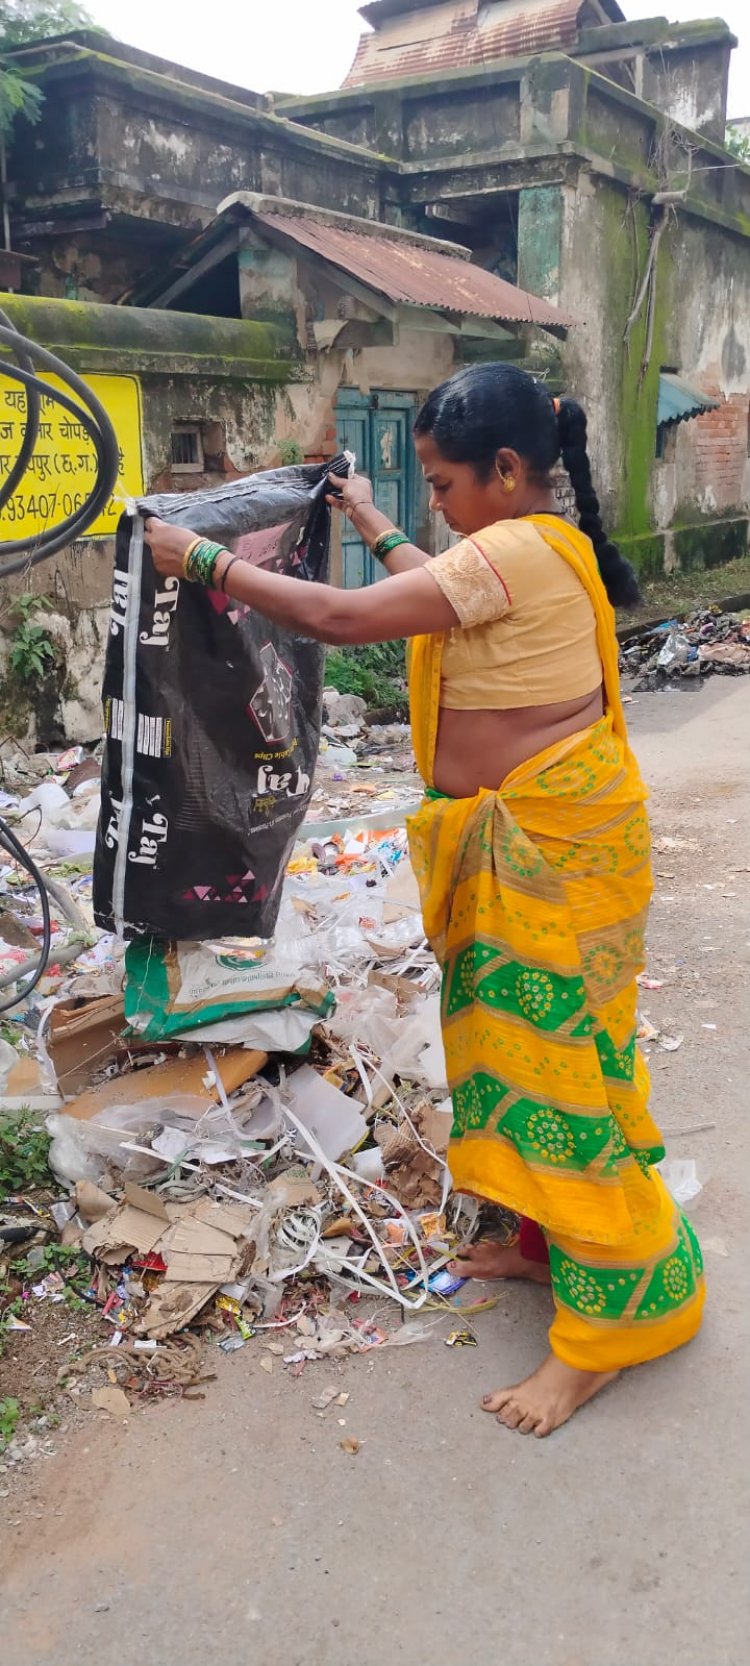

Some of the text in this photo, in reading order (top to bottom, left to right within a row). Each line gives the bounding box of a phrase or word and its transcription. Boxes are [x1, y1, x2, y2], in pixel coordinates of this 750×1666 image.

[139, 576, 179, 646] Taj
[257, 764, 310, 798] Taj
[128, 812, 169, 865] Taj
